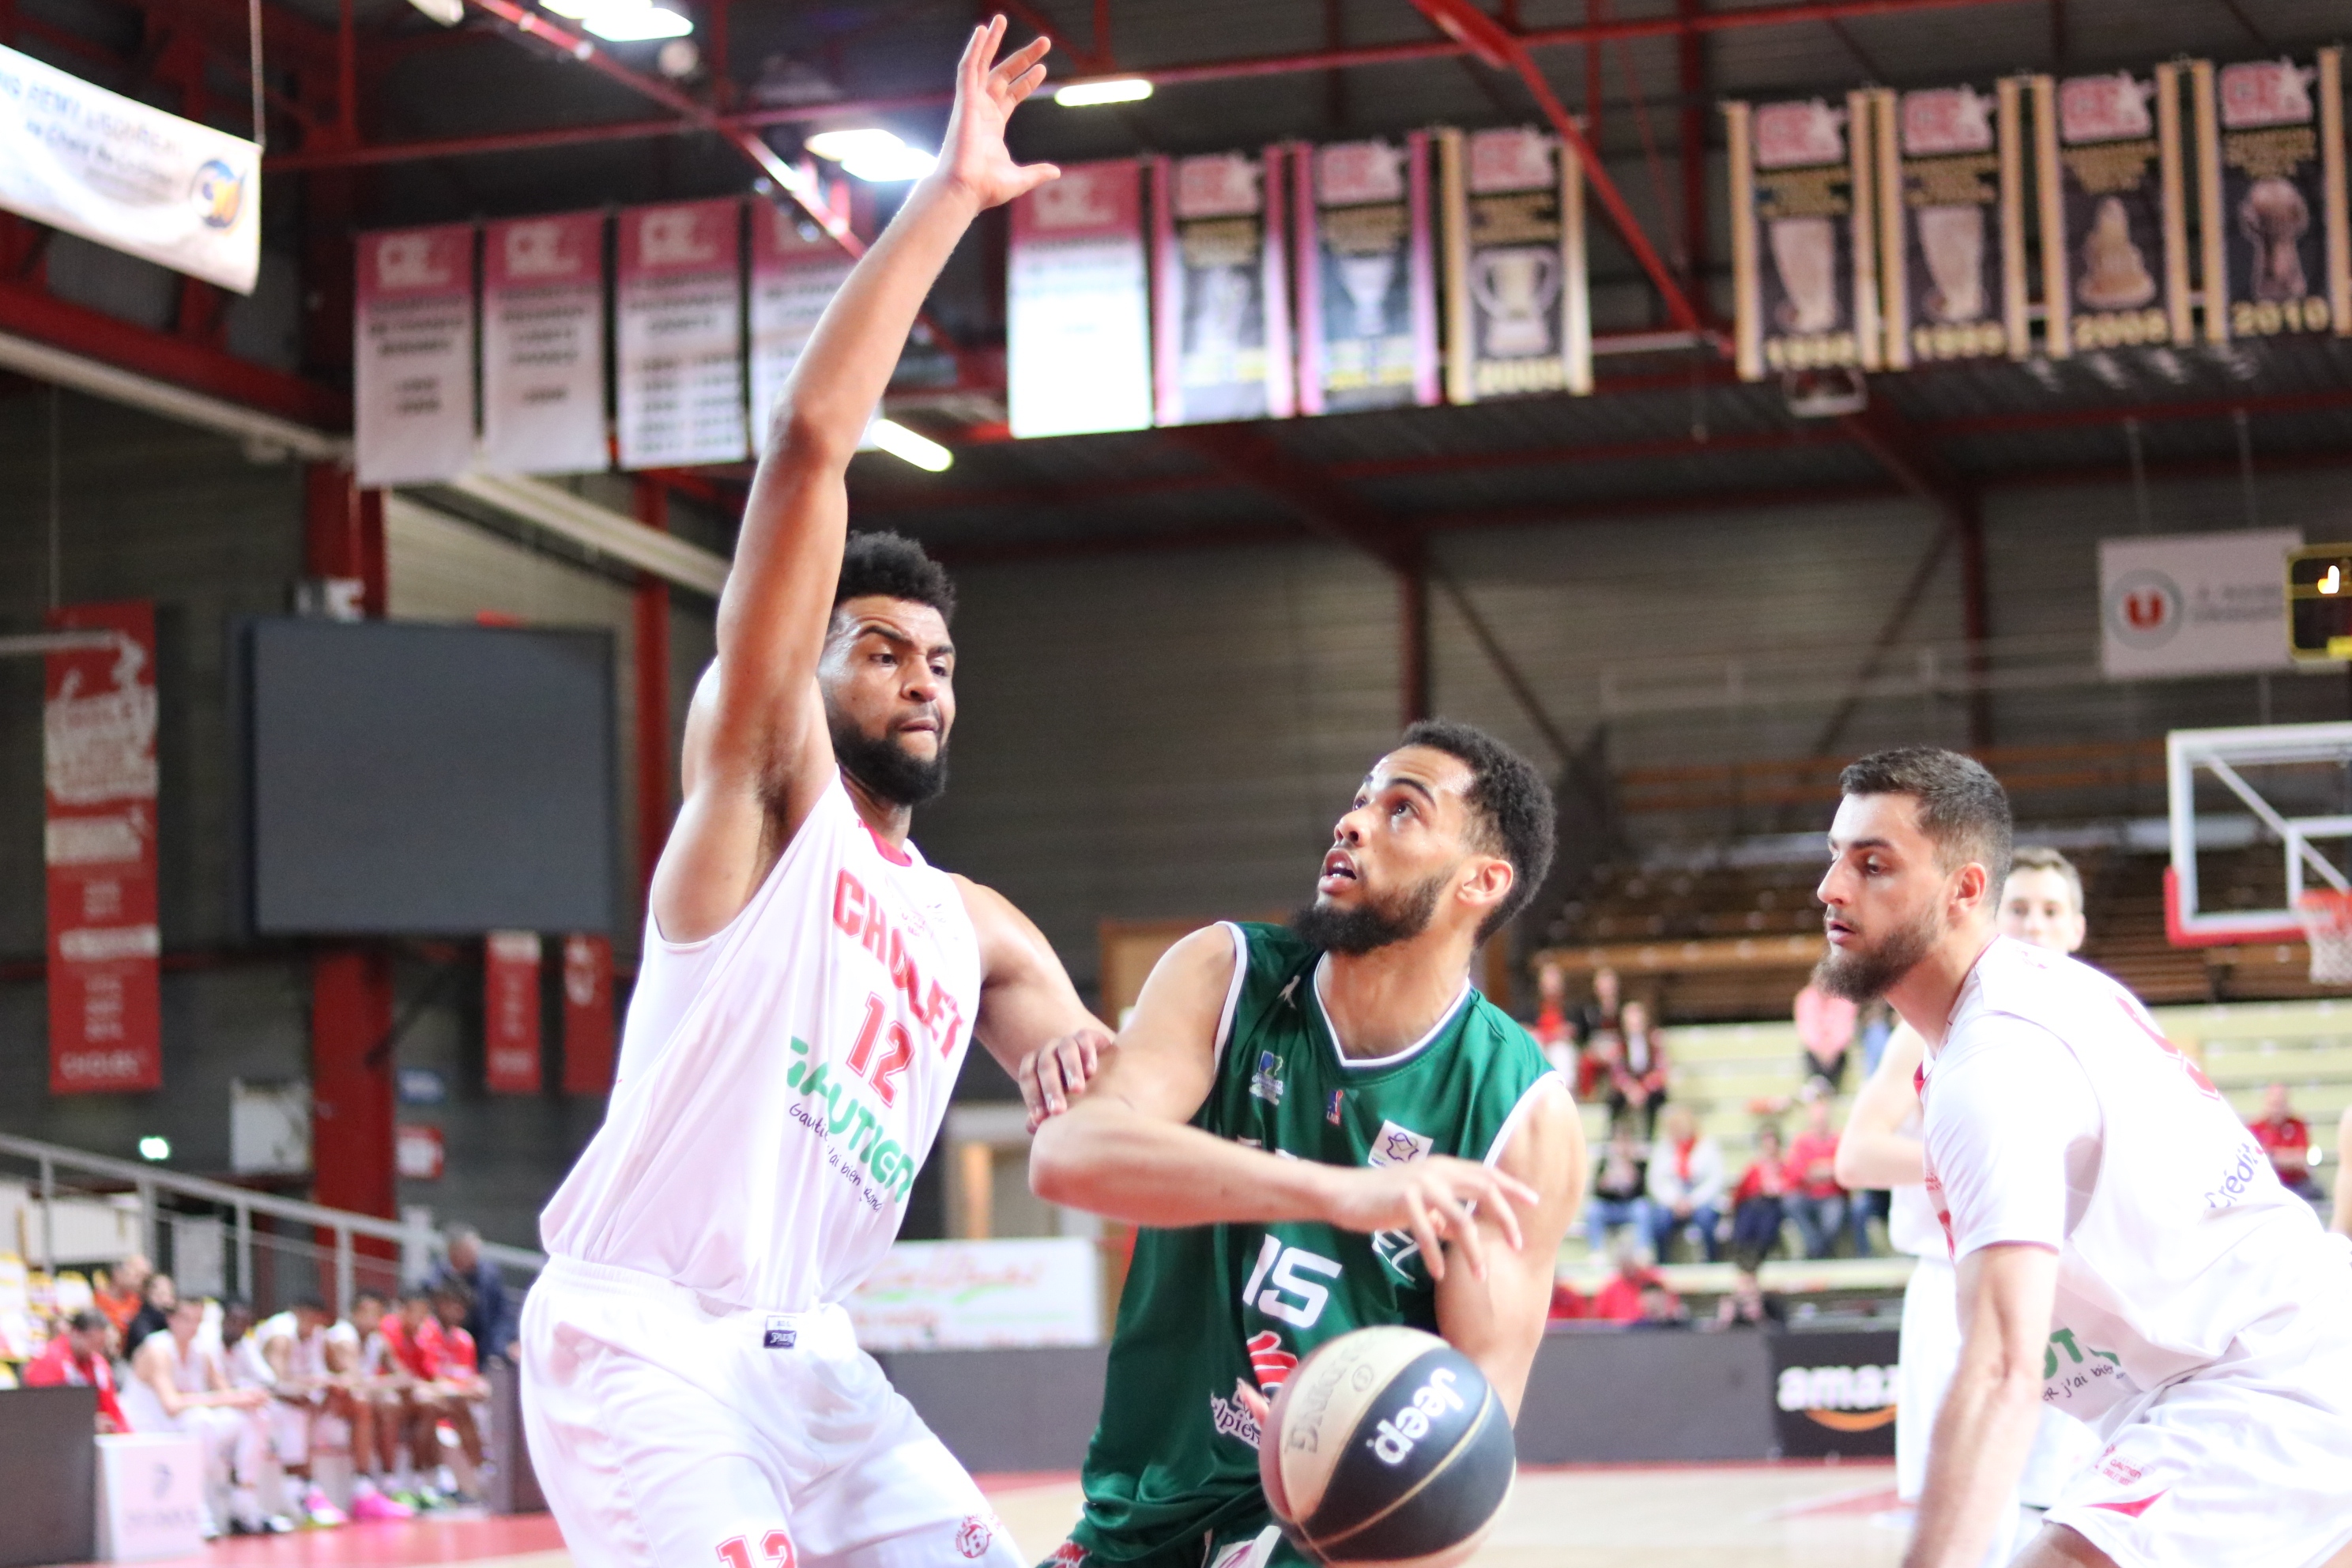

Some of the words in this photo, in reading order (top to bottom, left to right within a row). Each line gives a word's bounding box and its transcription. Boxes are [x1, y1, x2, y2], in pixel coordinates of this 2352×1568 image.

[832, 867, 966, 1062] CHOLET
[846, 991, 916, 1110] 12
[840, 1164, 861, 1187] bien
[1242, 1234, 1342, 1329] 15
[1374, 1368, 1464, 1465] Jeep
[2061, 1372, 2089, 1398] j'ai
[715, 1529, 799, 1568] 12
